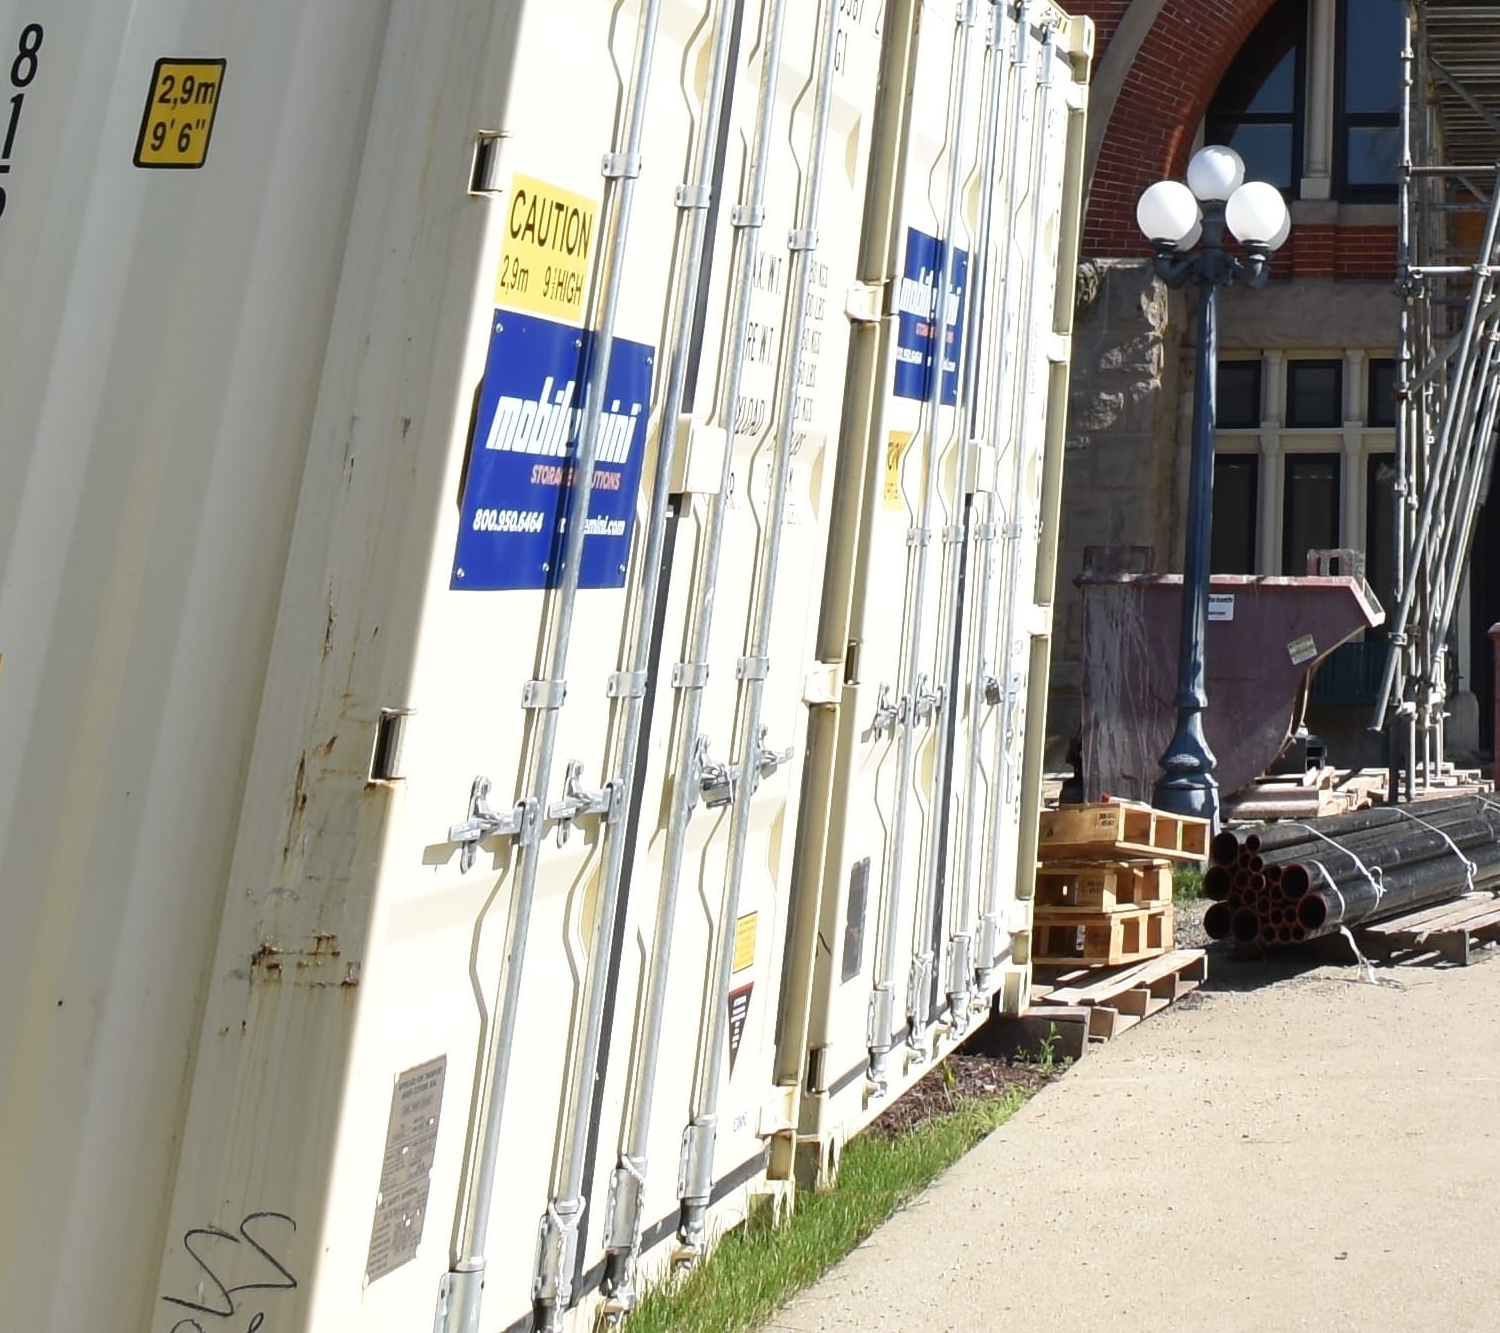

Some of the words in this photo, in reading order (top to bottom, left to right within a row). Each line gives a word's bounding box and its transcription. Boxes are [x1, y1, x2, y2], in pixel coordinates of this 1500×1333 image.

[158, 75, 216, 110] 2,9m
[509, 189, 593, 260] CAUTION
[500, 254, 529, 295] 2,9m
[594, 399, 642, 464] ini
[473, 509, 545, 533] 800.950.6464
